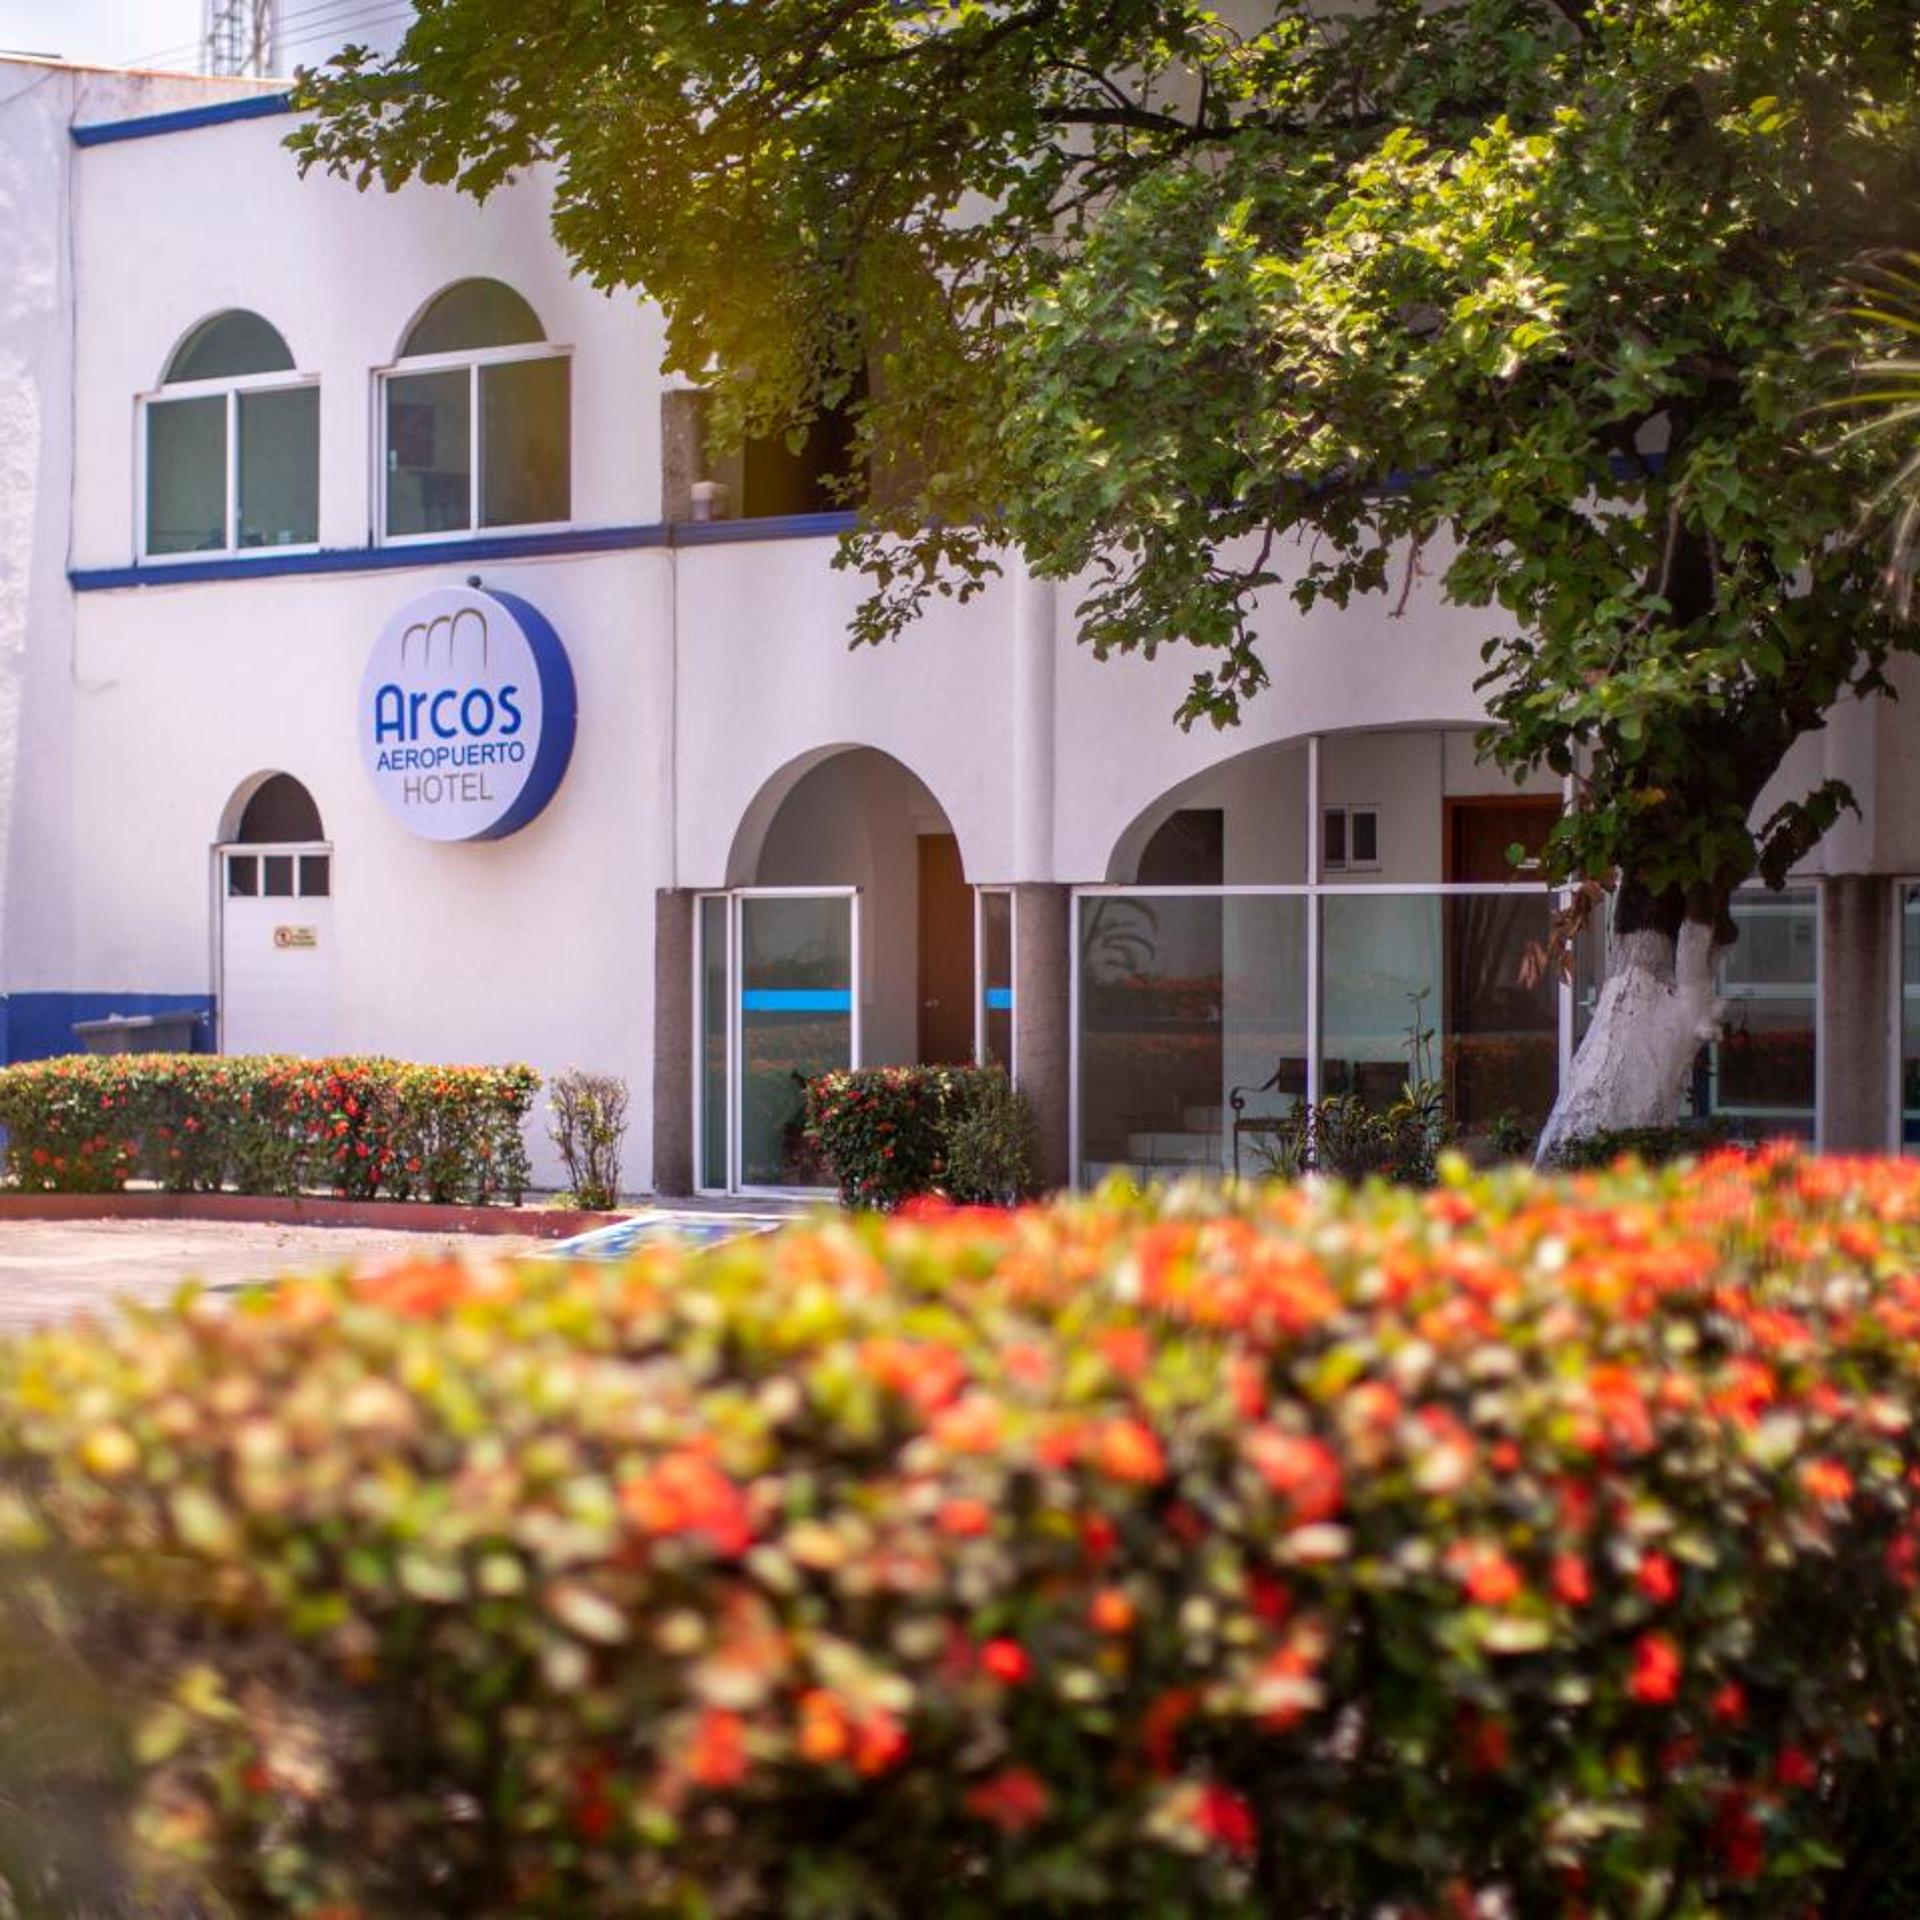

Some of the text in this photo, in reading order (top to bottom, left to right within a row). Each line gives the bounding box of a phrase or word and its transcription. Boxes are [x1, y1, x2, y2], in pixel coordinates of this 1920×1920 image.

[375, 684, 522, 744] Arcos
[376, 741, 525, 771] AEROPUERTO
[403, 772, 494, 804] HOTEL
